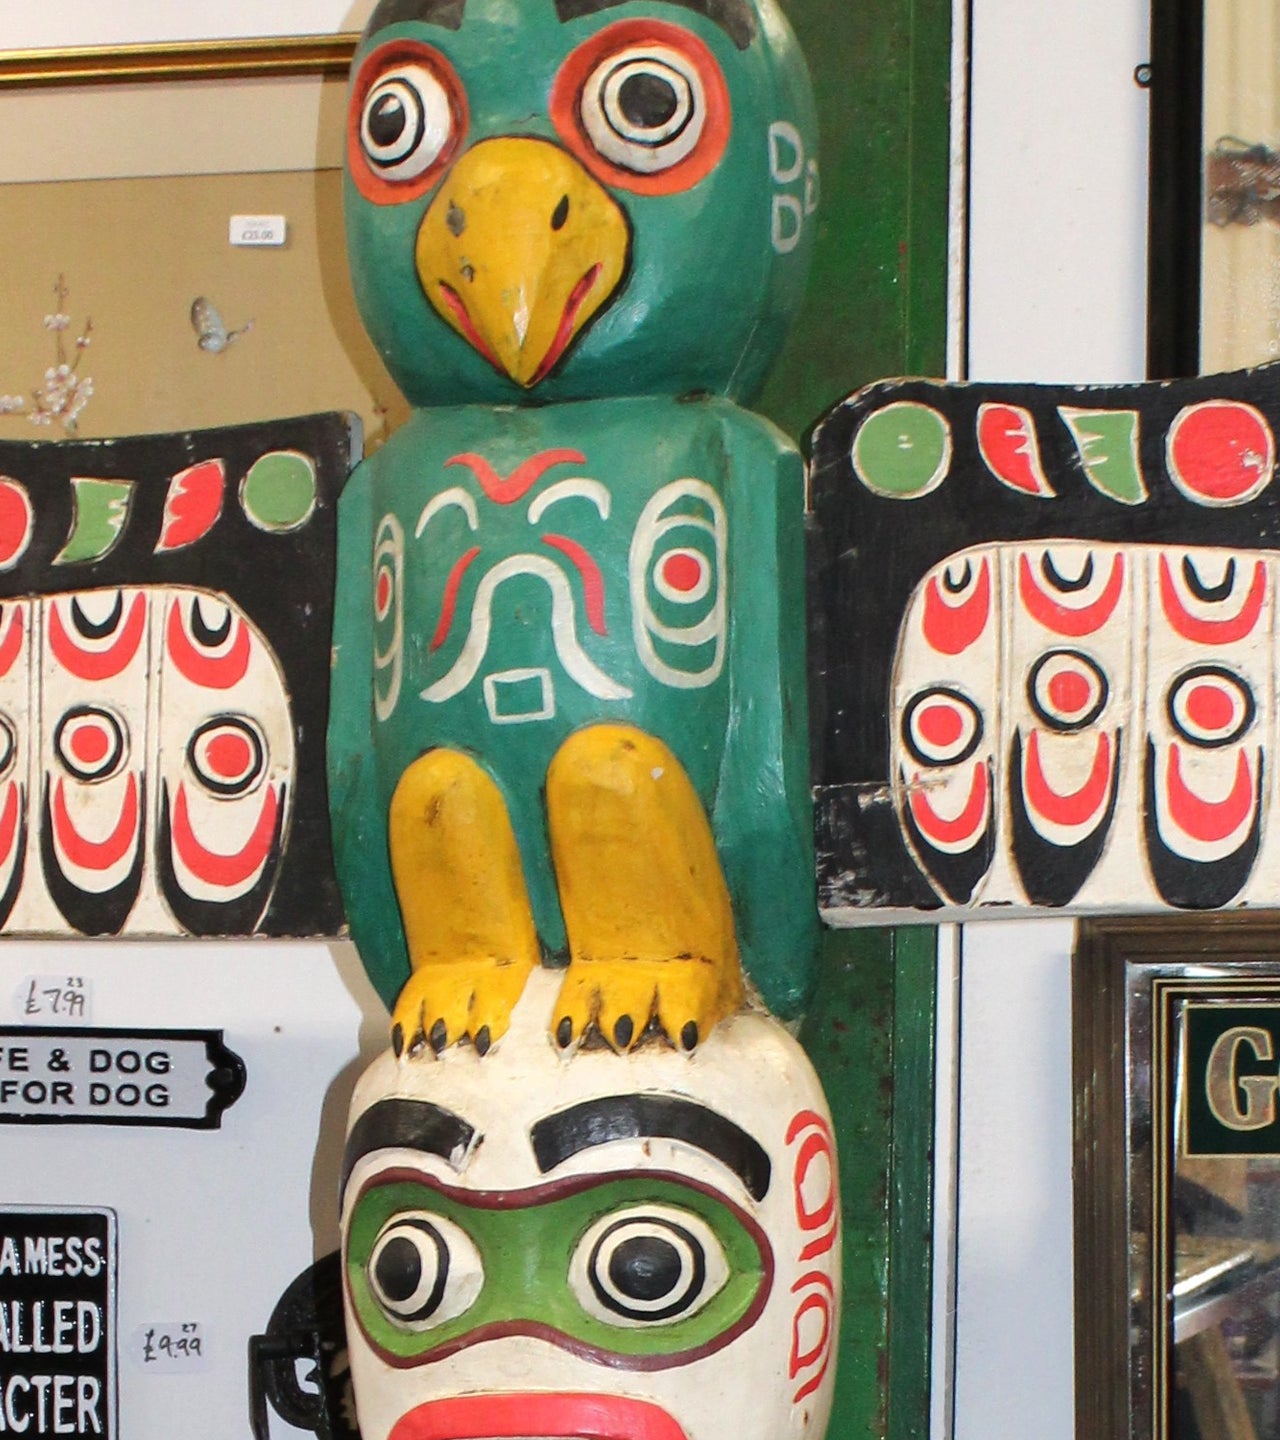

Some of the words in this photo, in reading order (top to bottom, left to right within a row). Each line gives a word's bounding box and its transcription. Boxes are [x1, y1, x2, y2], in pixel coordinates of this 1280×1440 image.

[24, 980, 85, 1017] £7.99
[47, 1048, 70, 1072] &
[89, 1049, 171, 1074] DOG
[0, 1080, 75, 1105] FOR
[89, 1082, 171, 1107] DOG
[24, 1236, 103, 1277] MESS
[143, 1328, 201, 1362] £9.99
